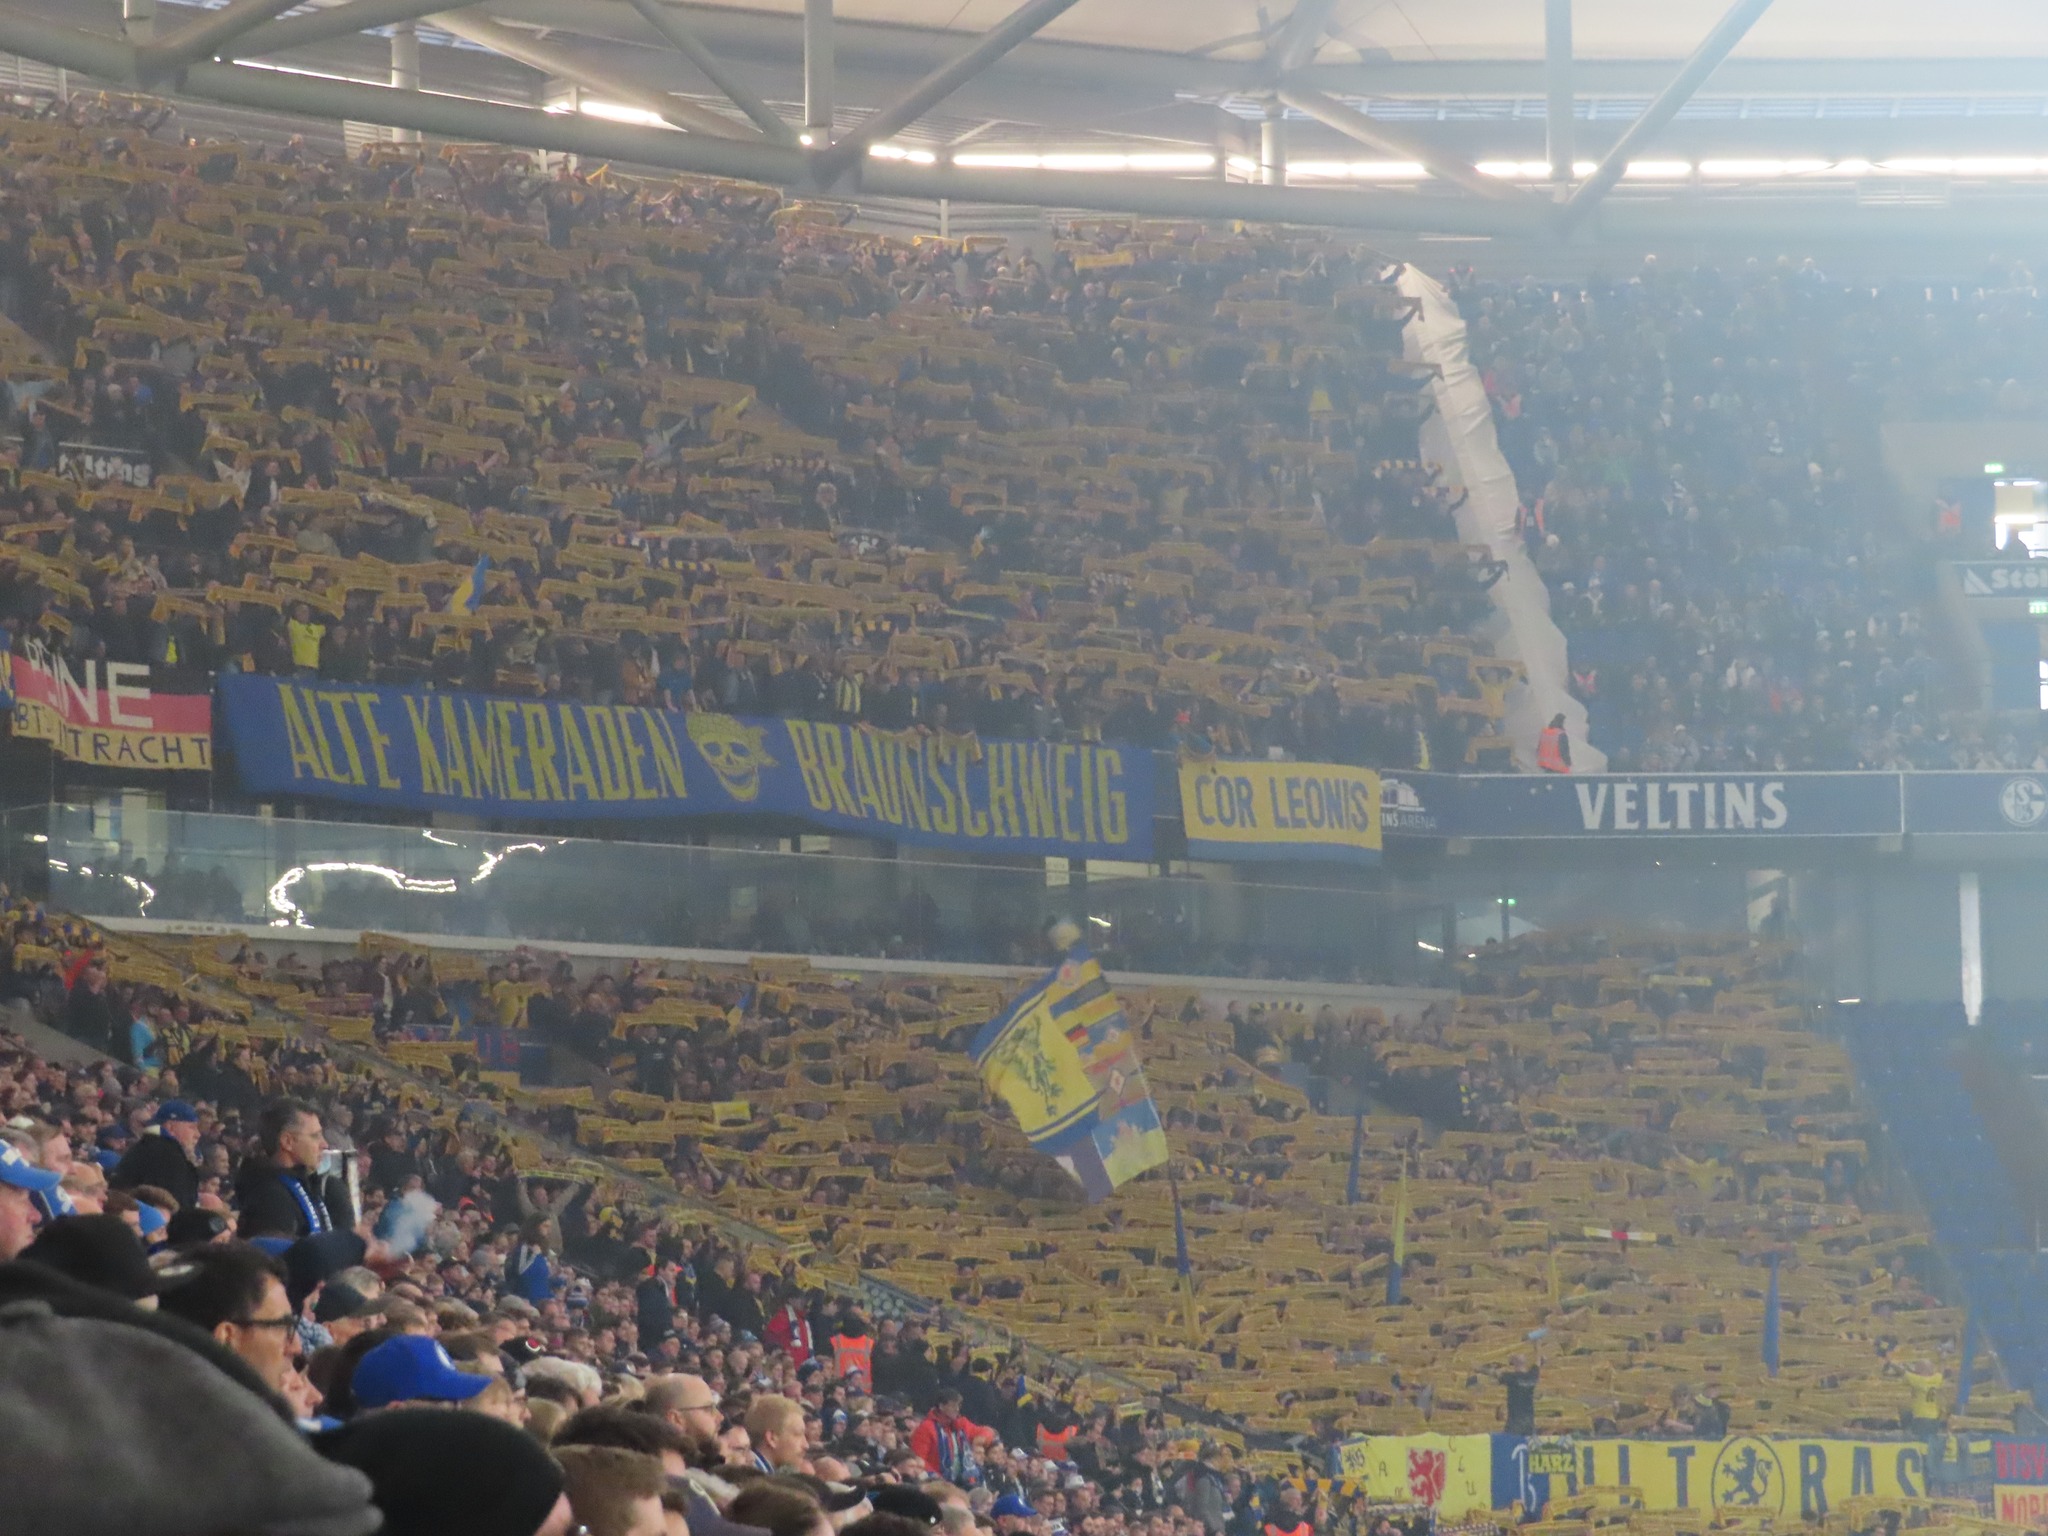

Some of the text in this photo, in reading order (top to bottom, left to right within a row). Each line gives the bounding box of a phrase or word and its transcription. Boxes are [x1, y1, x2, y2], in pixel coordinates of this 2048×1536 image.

[276, 682, 1128, 845] ALTE KAMERADEN BRAUNSCHWEIG
[1194, 774, 1369, 833] COR LEONIS
[1574, 782, 1789, 830] VELTINS
[1528, 1453, 1576, 1473] HARZ
